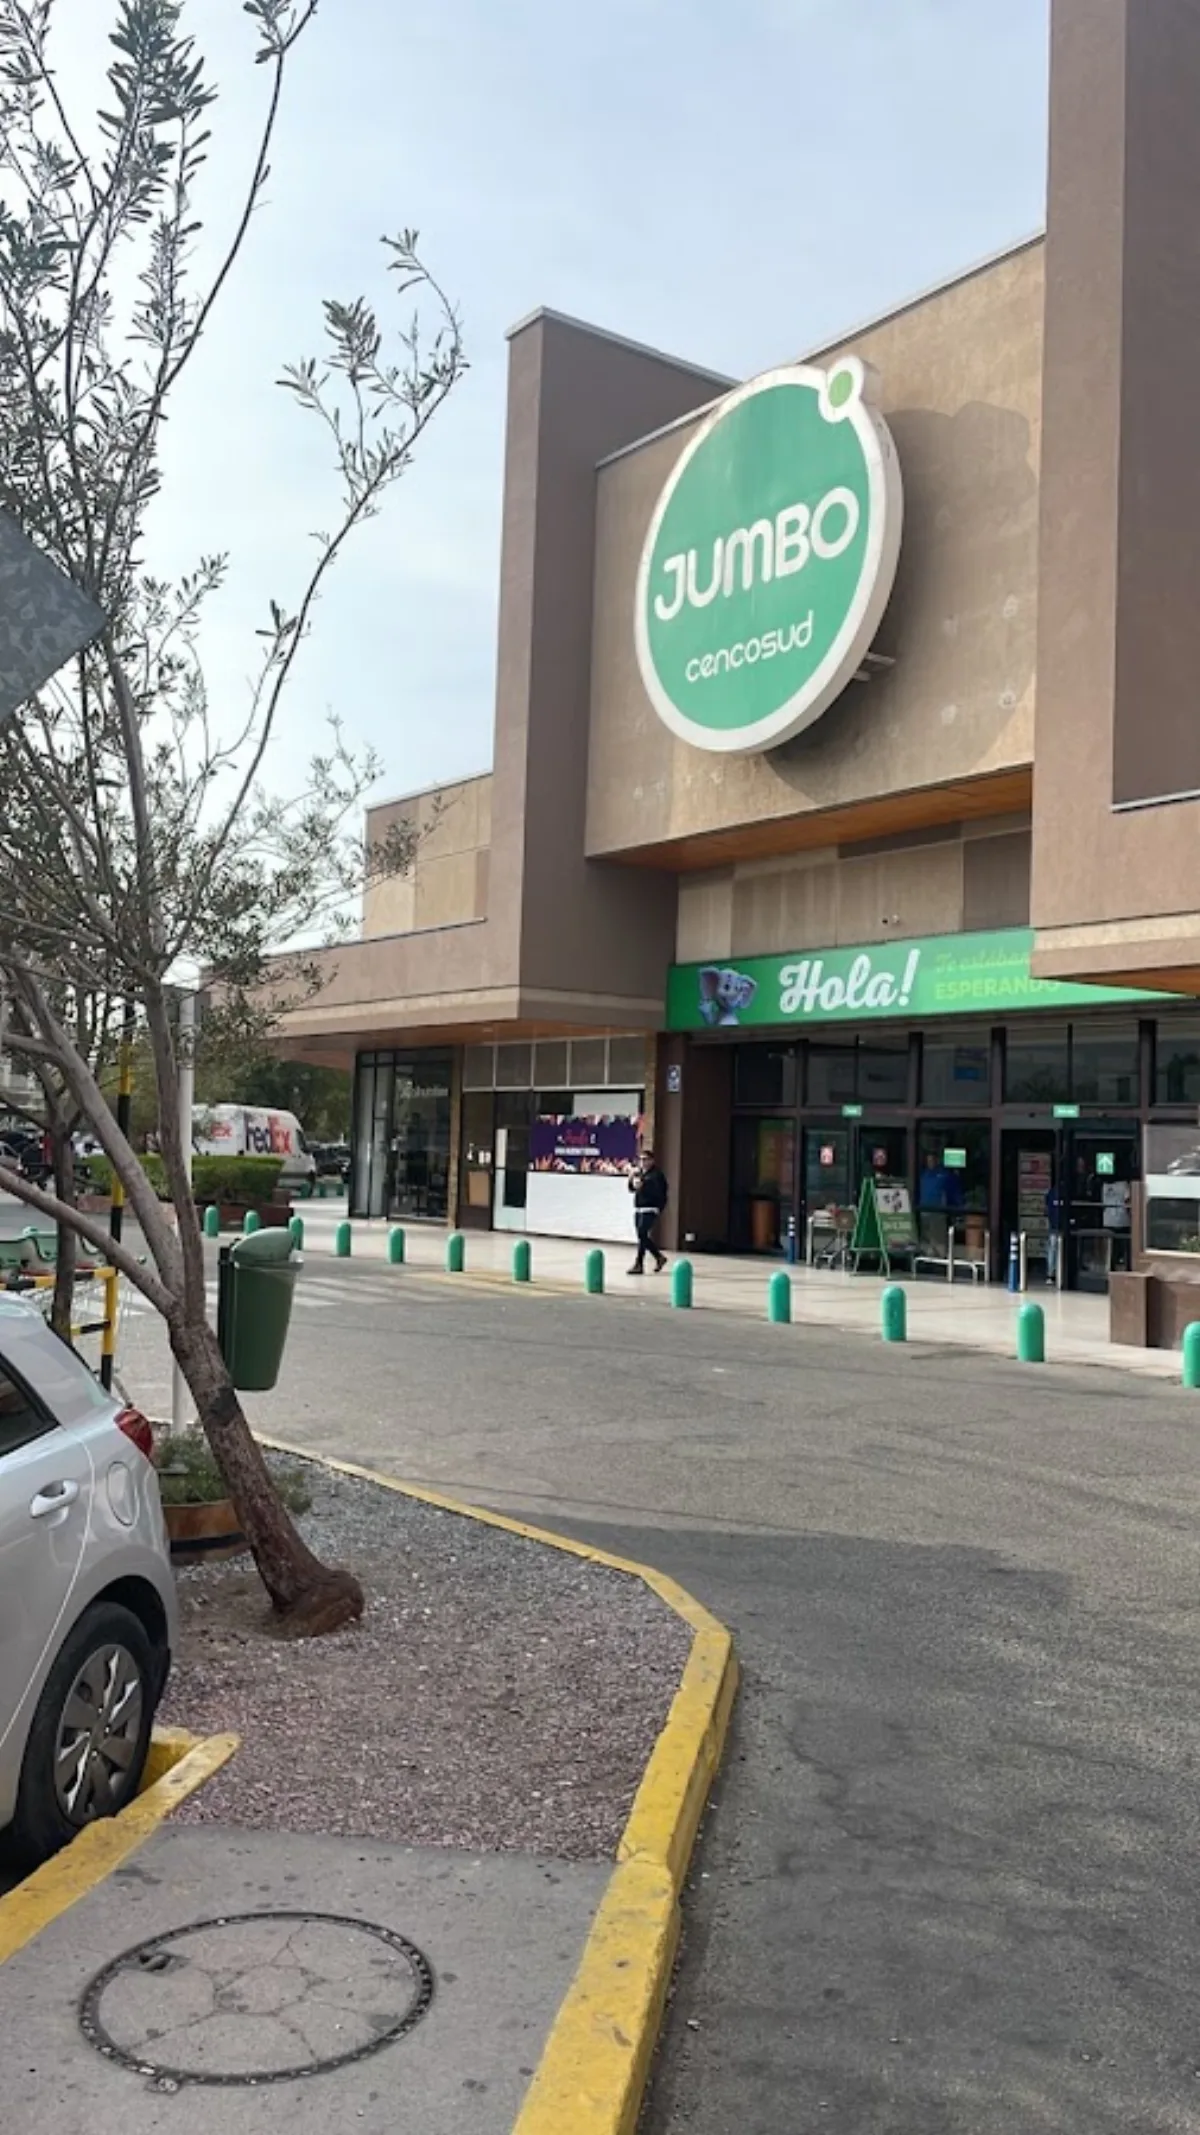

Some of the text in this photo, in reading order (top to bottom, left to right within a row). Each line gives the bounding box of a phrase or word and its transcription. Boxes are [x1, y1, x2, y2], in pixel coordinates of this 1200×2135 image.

[654, 486, 859, 621] JUMBO
[685, 610, 814, 683] cencosud
[779, 948, 920, 1013] Hola!
